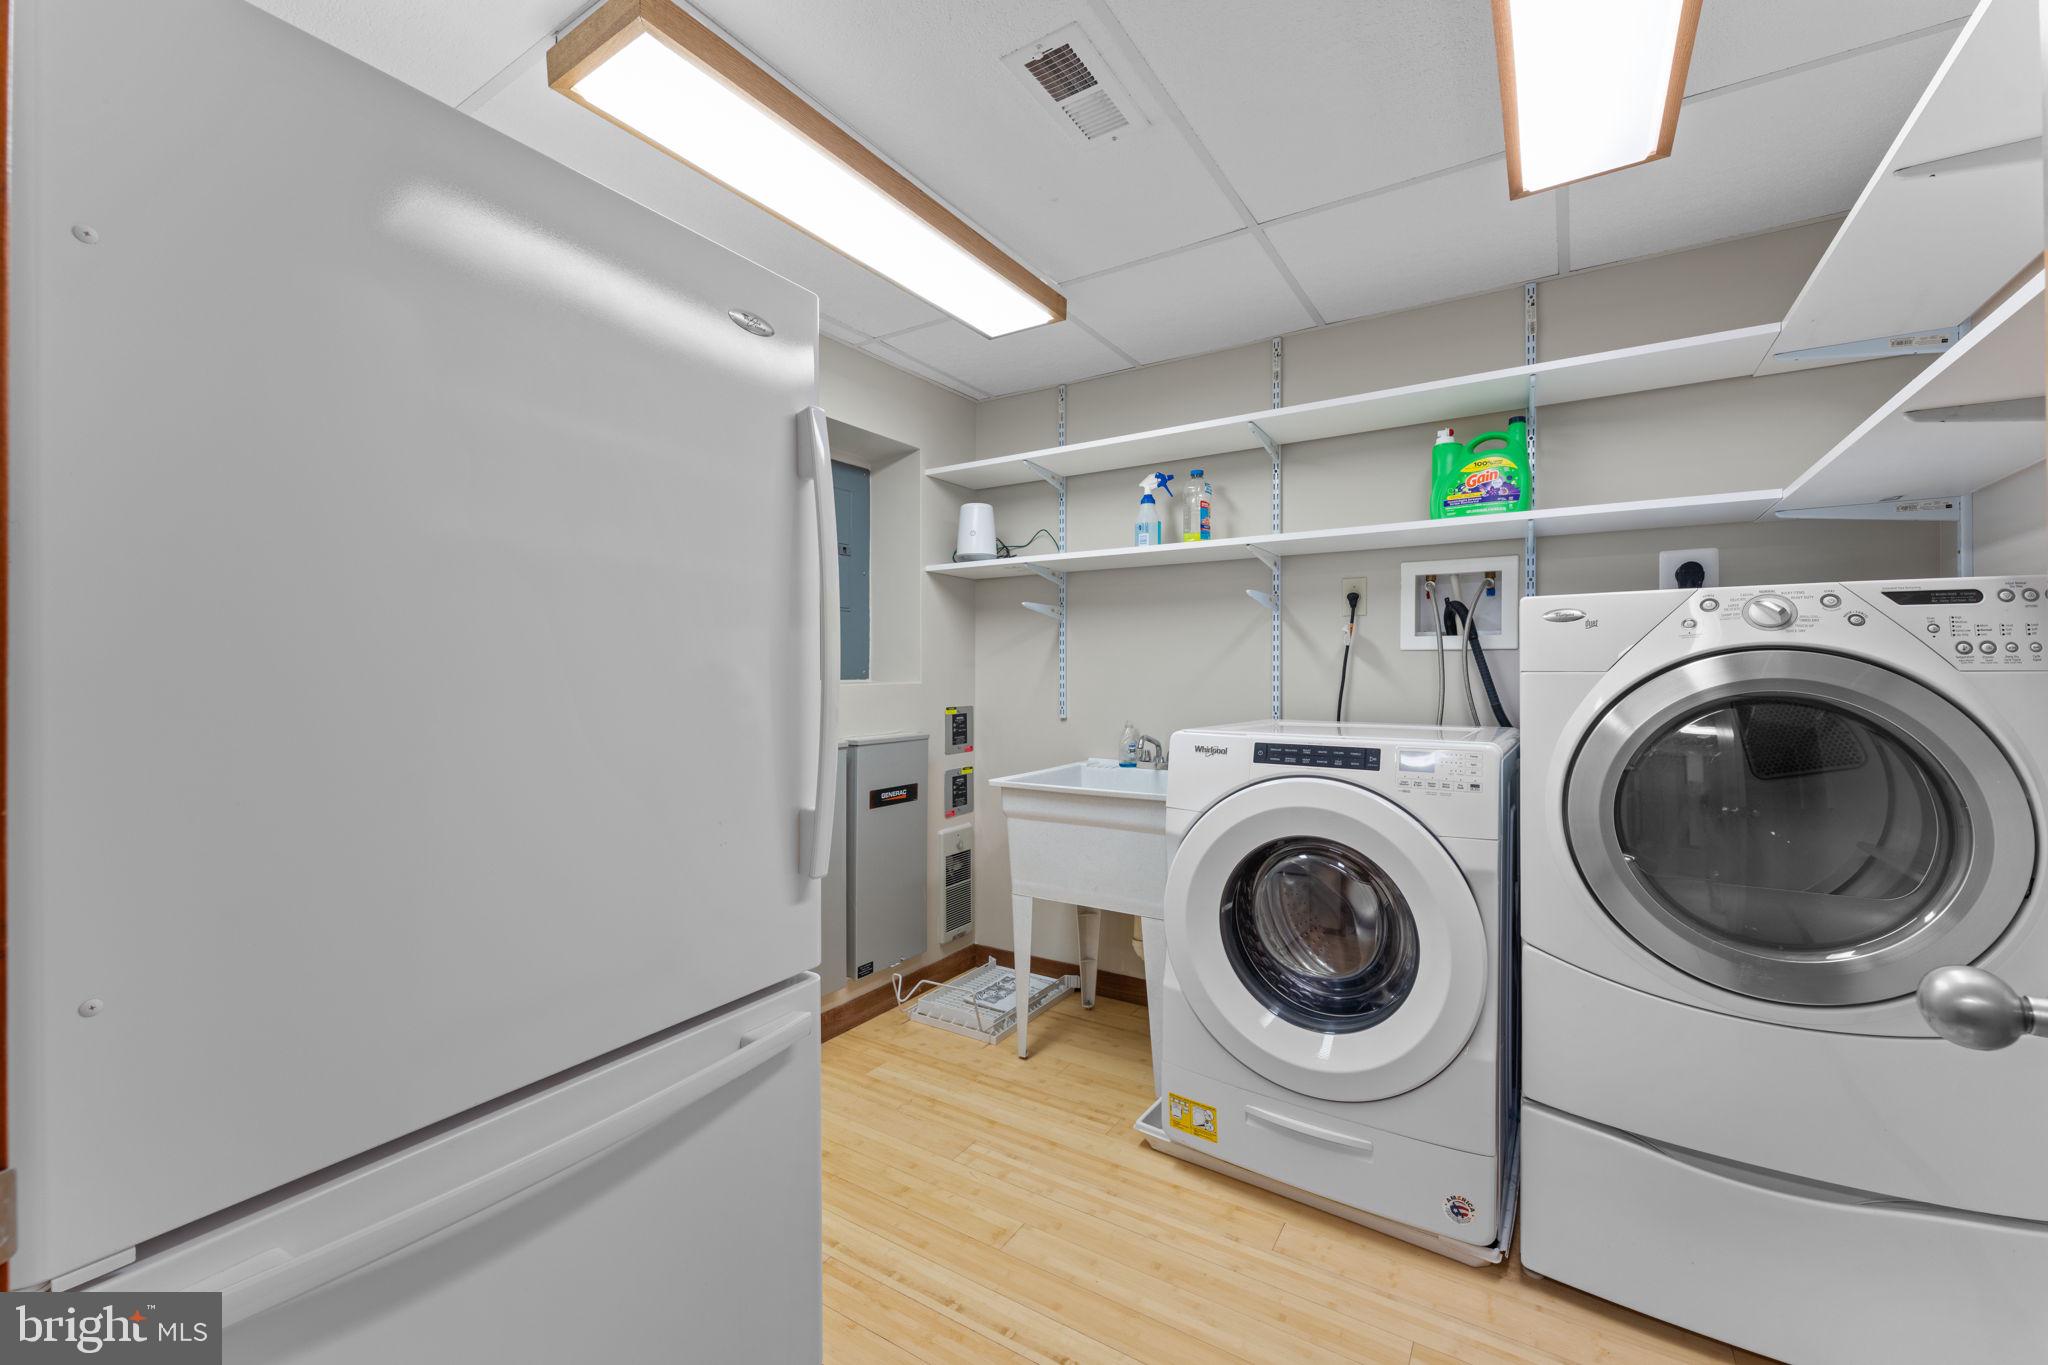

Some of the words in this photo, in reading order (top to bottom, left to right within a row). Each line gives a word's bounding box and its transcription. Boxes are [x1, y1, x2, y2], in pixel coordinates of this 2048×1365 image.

[1466, 469, 1499, 488] Gain
[1194, 745, 1228, 757] Whirlpool
[881, 789, 907, 799] GENERAC
[1446, 1195, 1475, 1213] AMERICA
